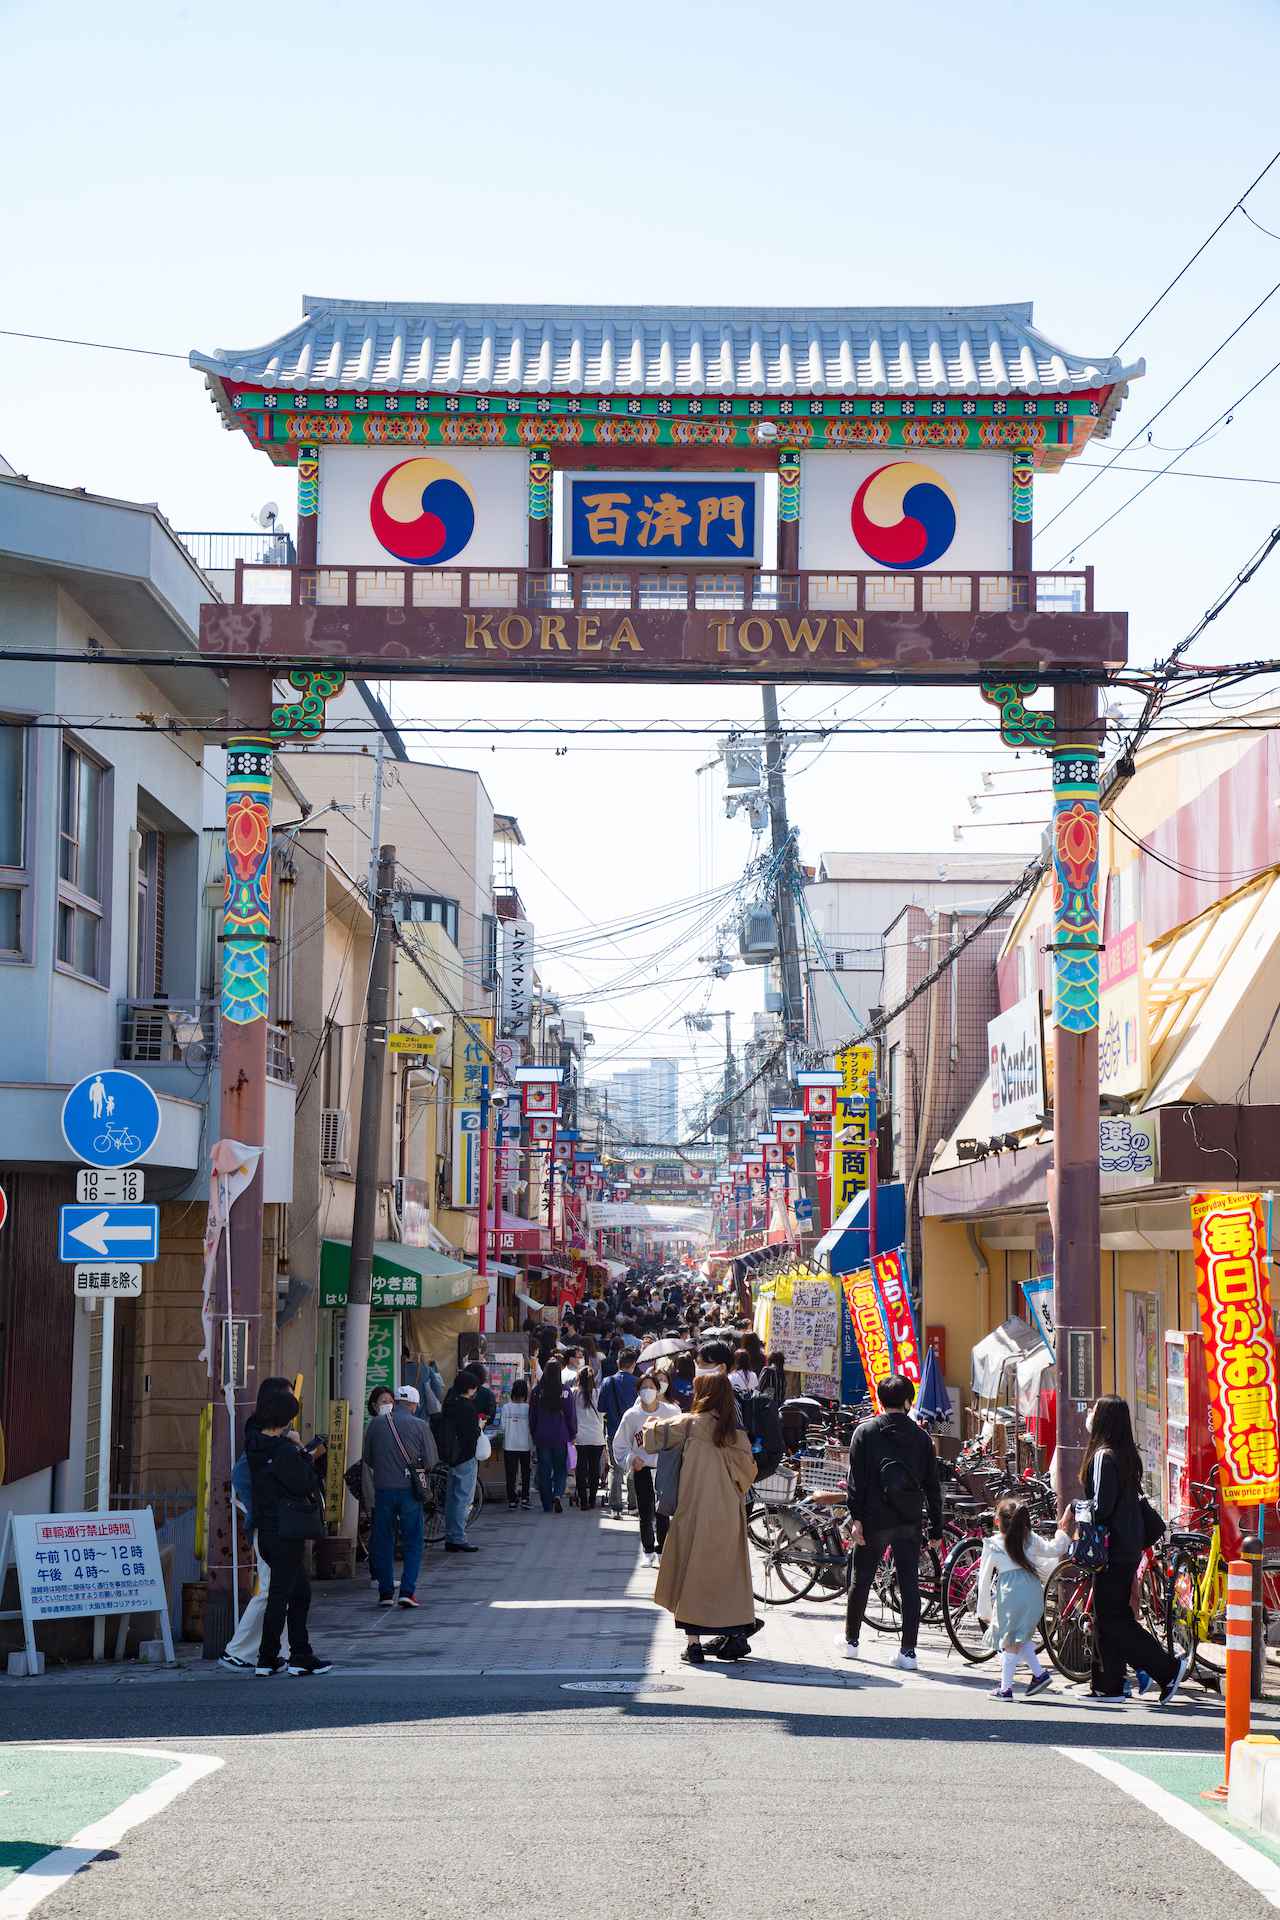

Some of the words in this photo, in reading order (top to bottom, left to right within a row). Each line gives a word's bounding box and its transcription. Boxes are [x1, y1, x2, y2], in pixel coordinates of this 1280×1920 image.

[581, 492, 746, 549] 百済門
[463, 614, 644, 651] KOREA
[707, 617, 865, 653] TOWN
[1100, 1120, 1150, 1152] 薬の
[1099, 1150, 1153, 1172] ヒグチ
[83, 1172, 98, 1186] 10
[122, 1172, 137, 1186] 12
[83, 1187, 98, 1201] 16
[122, 1187, 137, 1201] 18
[78, 1271, 138, 1290] 自転車を除く
[372, 1275, 418, 1292] ゆき森
[852, 1284, 893, 1385] 毎日がお
[1207, 1214, 1278, 1479] 毎日がお買得
